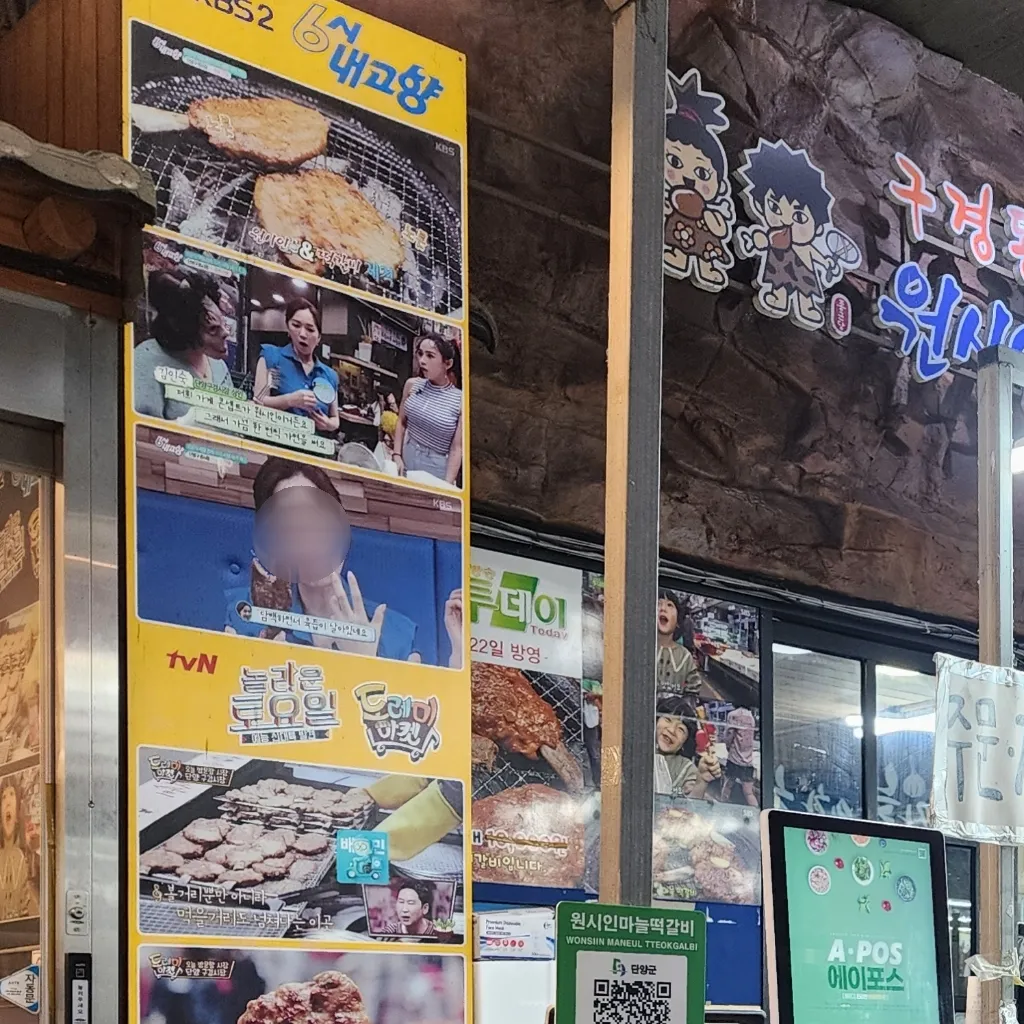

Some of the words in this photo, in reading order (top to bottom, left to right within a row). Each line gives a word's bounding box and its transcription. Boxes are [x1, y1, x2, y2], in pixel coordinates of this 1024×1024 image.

[195, 0, 274, 31] BS2
[329, 44, 444, 115] 내고향
[435, 142, 455, 157] KBS
[433, 500, 453, 511] KBS
[531, 625, 568, 640] Today
[166, 650, 218, 674] tvN
[470, 637, 504, 658] 22일
[511, 643, 540, 664] 방영
[242, 660, 324, 693] 놀라운
[229, 690, 341, 733] 토요일
[355, 683, 438, 727] 도레미
[374, 720, 421, 745] 마켓
[472, 853, 547, 873] 갈비입니다.
[164, 886, 228, 906] 볼거리뿐만
[230, 890, 267, 906] 아니라
[176, 907, 249, 928] 먹을거리도
[252, 913, 307, 931] 넘쳐나는
[308, 914, 334, 930] 이곳
[570, 912, 694, 937] 원시인마늘떡갈비
[566, 936, 604, 946] WONSIIN
[607, 938, 642, 948] MANEUL
[645, 940, 698, 951] TTEOKGALBI
[827, 938, 903, 966] A·POS
[631, 964, 657, 975] 단양군
[828, 965, 904, 991] 에이포스
[24, 973, 36, 1004] 자동문
